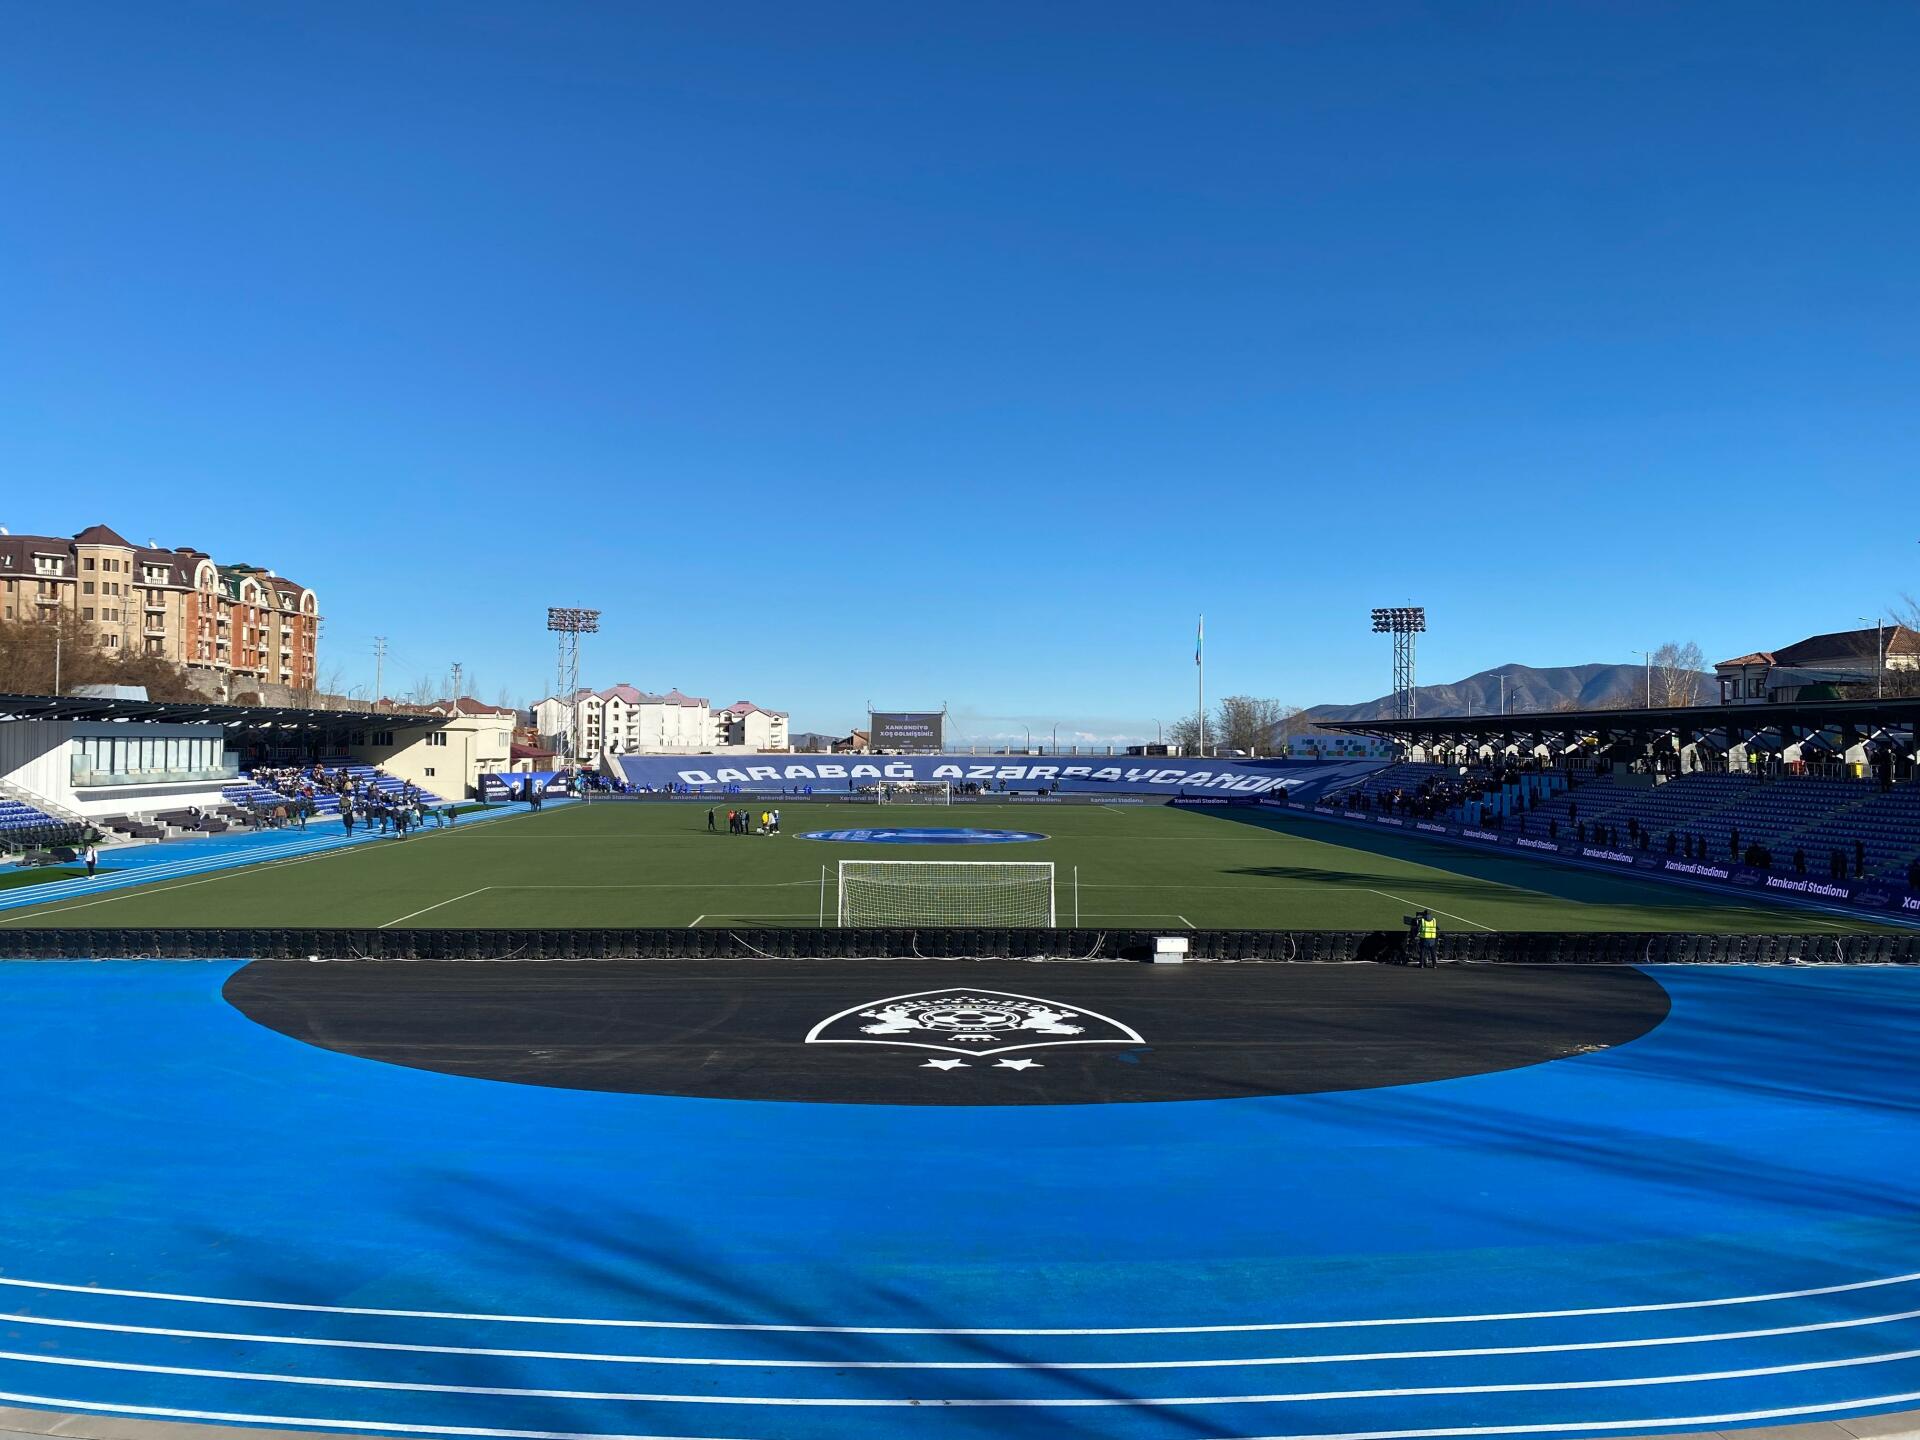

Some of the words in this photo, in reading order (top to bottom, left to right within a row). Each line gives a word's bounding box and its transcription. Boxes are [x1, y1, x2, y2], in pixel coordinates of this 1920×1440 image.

[677, 761, 915, 785] QARABAĞ
[1697, 865, 1728, 879] Stadionu
[1766, 876, 1808, 891] Xankəndi
[1807, 882, 1849, 898] Stadionu
